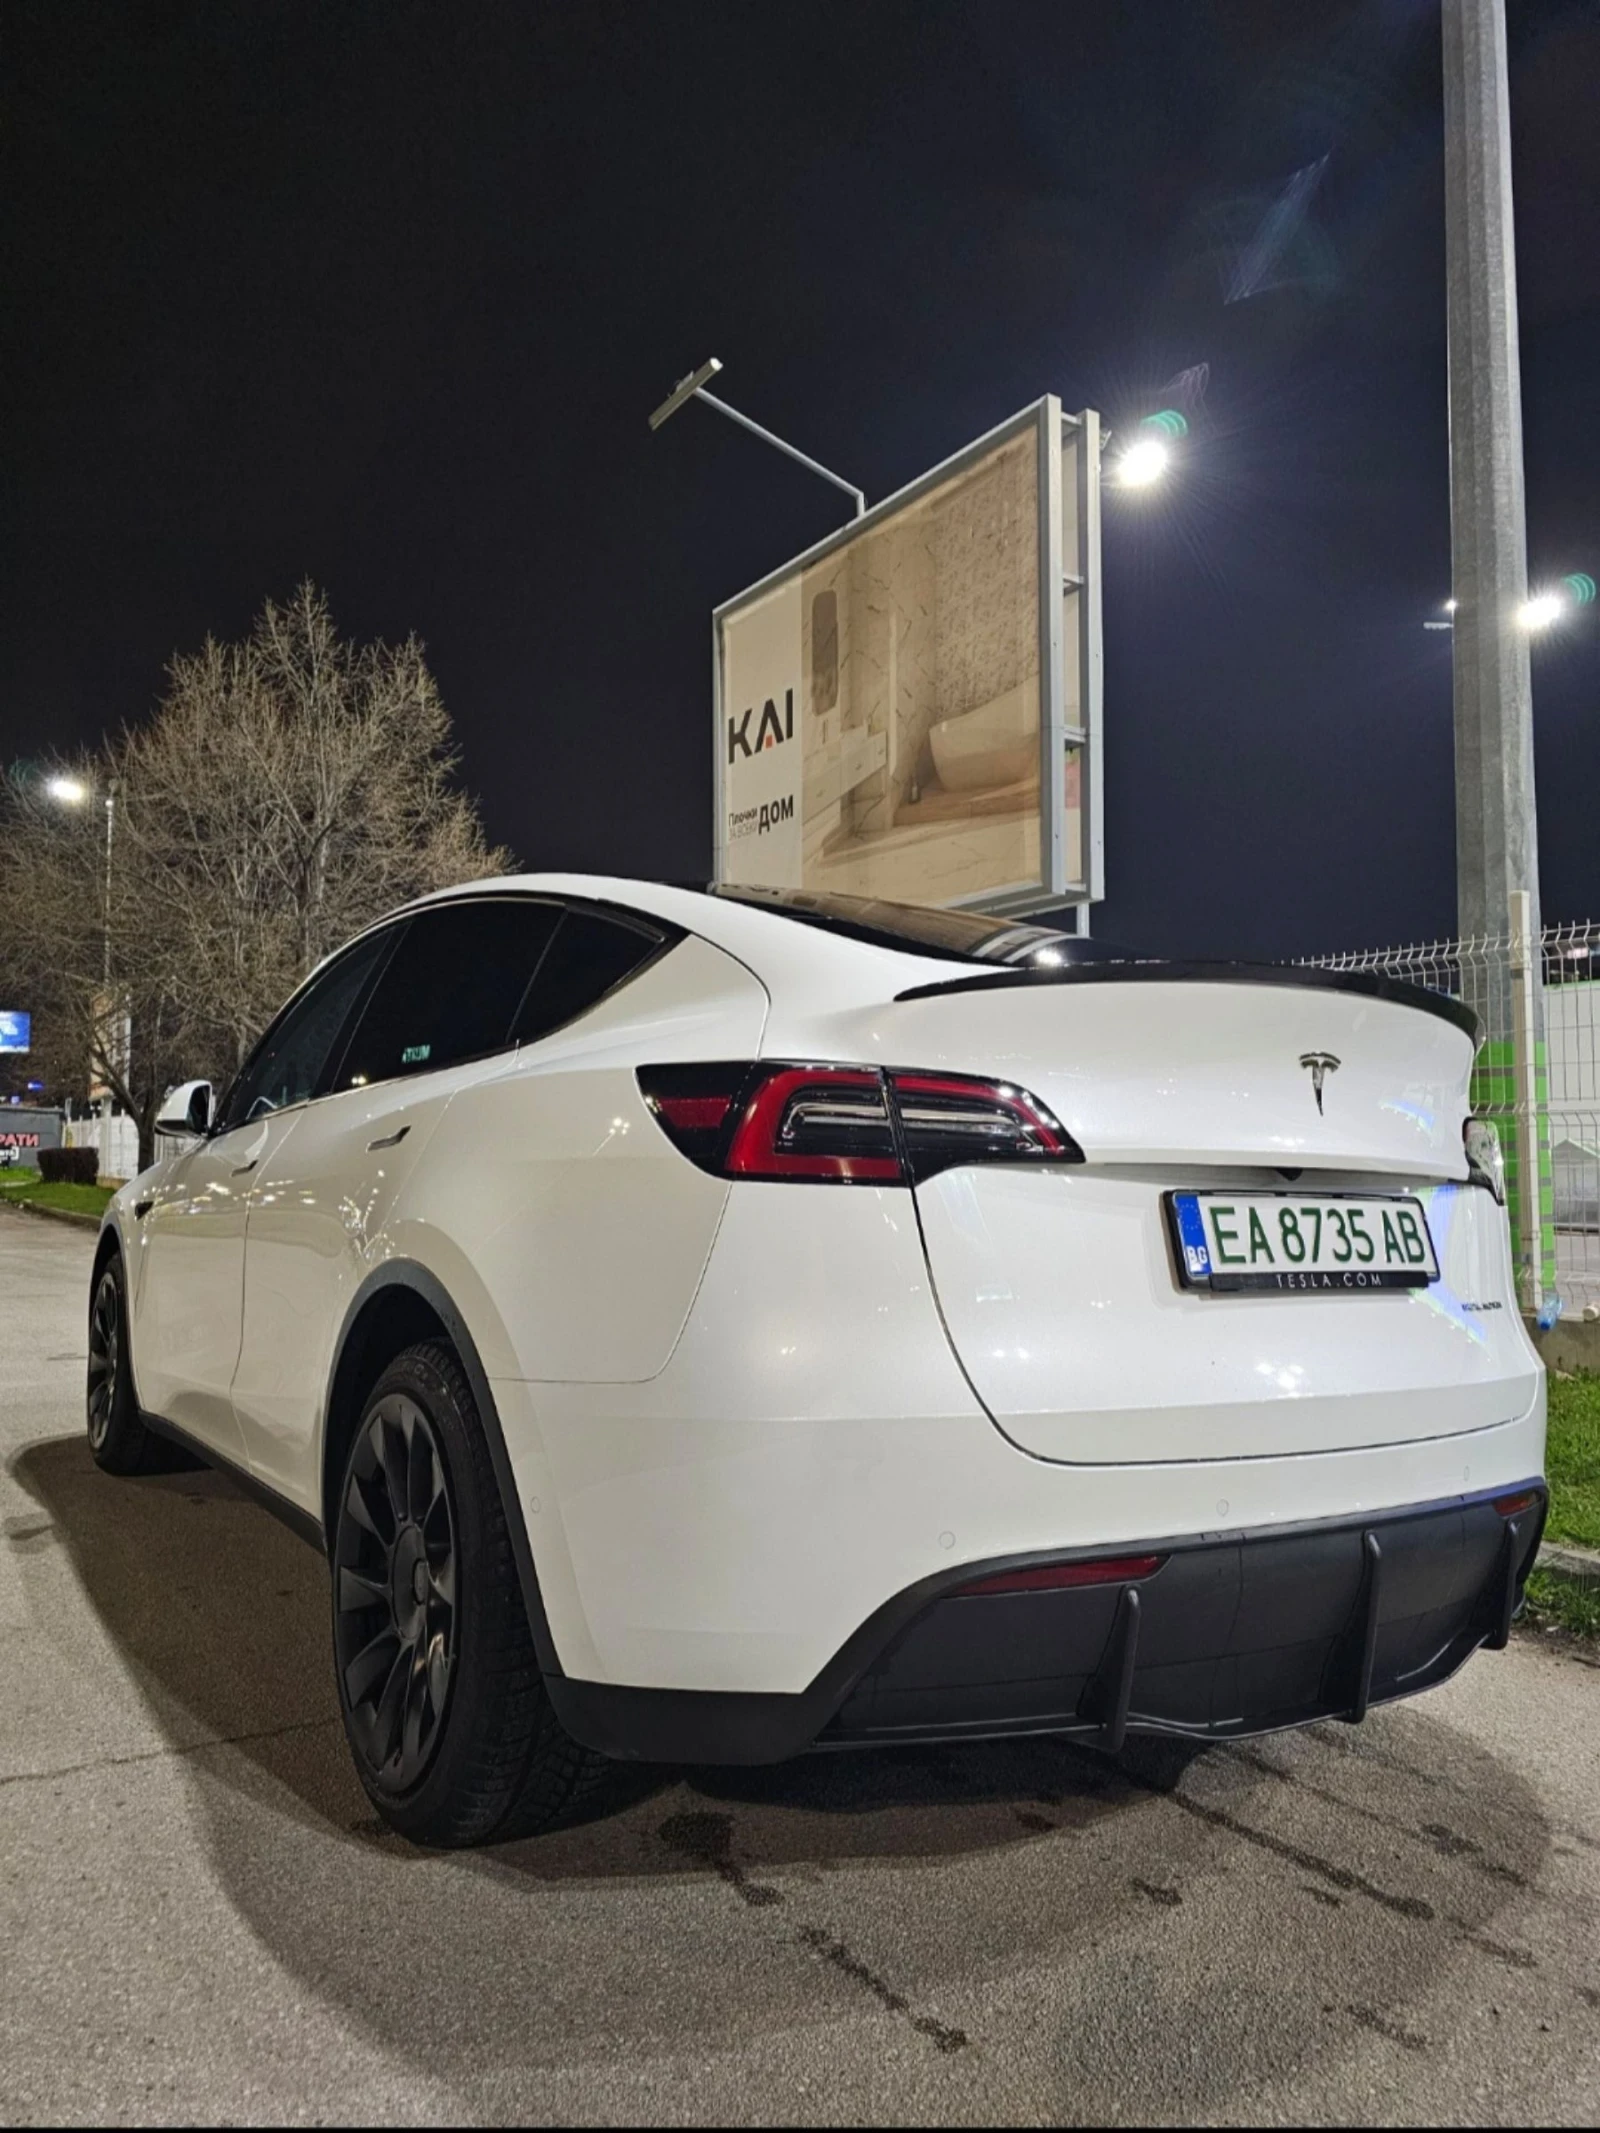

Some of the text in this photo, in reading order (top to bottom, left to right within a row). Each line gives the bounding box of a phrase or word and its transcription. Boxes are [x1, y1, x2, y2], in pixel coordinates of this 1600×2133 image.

[728, 687, 794, 765] KAI
[758, 794, 794, 835] ДОМ
[1185, 1245, 1208, 1265] BG
[1209, 1206, 1426, 1264] EA 8735 AB
[1275, 1271, 1382, 1288] TESLA.COM
